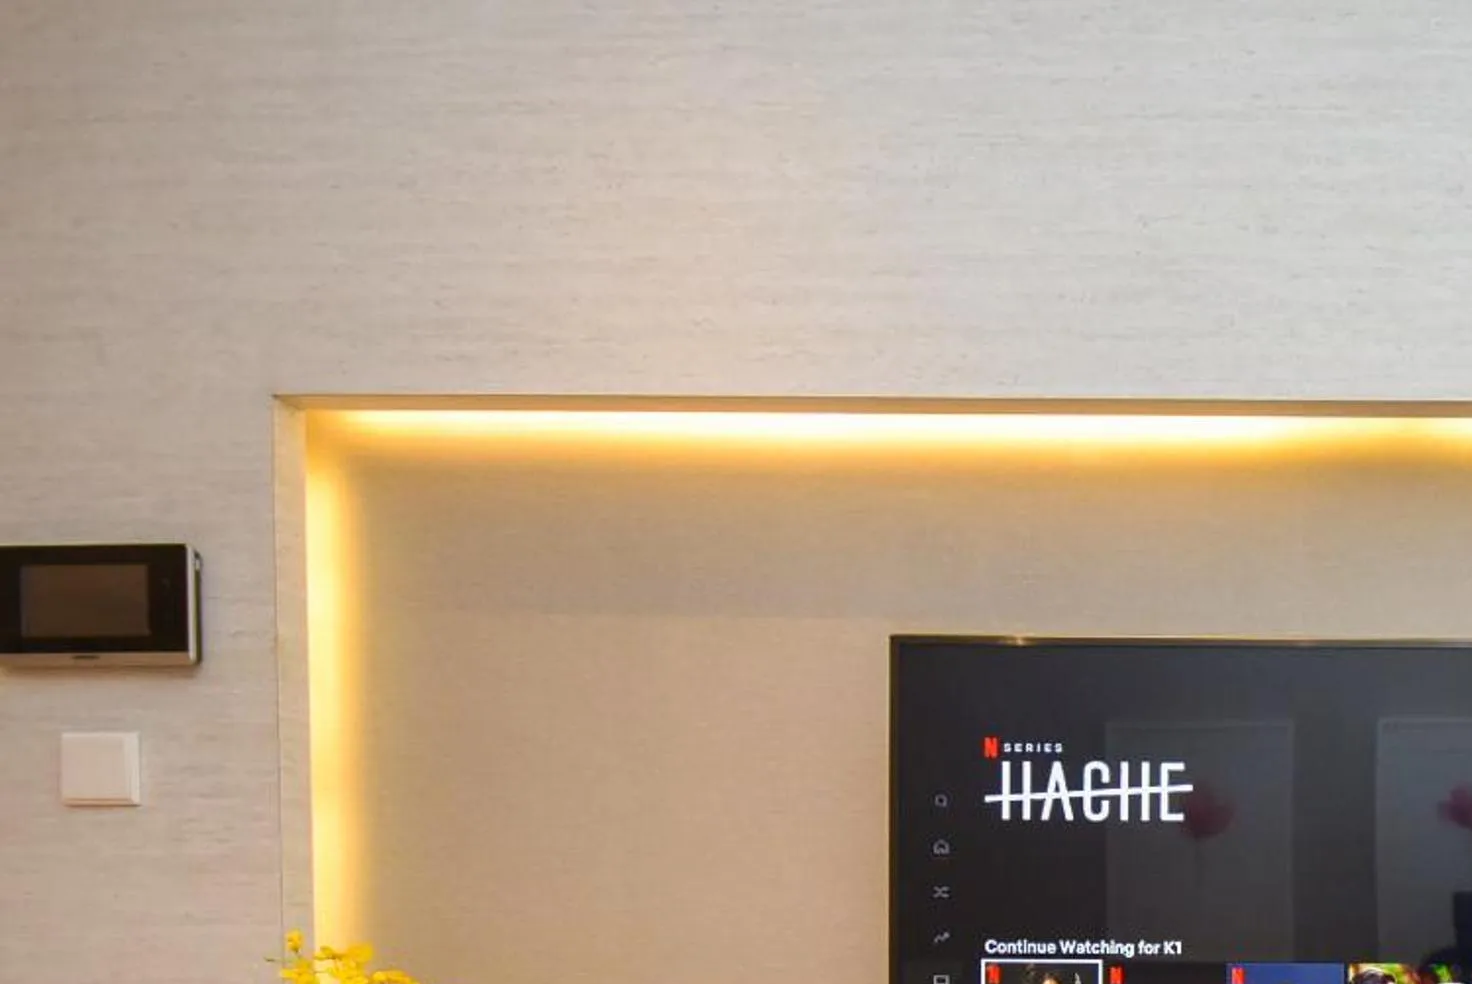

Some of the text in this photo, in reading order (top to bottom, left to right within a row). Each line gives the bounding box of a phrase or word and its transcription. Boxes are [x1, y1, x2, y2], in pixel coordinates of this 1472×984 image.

[1004, 743, 1063, 753] SERIES
[985, 761, 1193, 821] HACHE
[985, 940, 1182, 958] Continue Watching for K1
